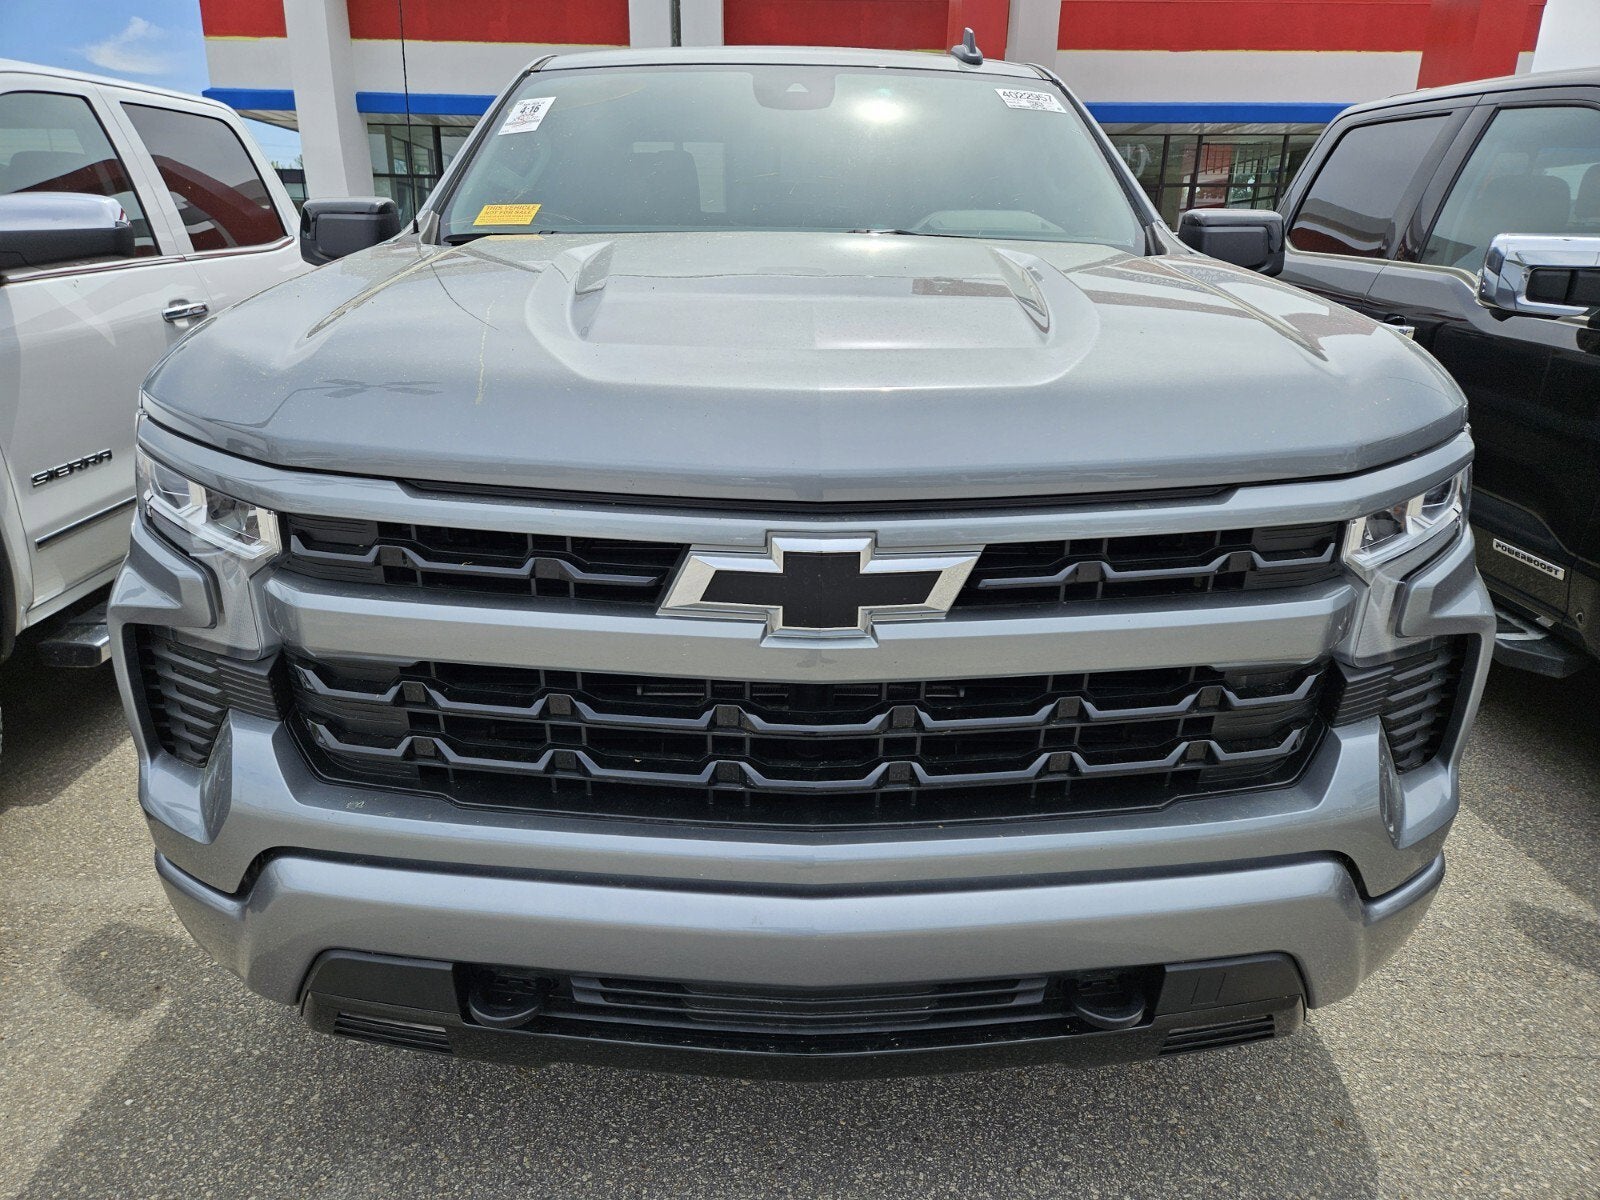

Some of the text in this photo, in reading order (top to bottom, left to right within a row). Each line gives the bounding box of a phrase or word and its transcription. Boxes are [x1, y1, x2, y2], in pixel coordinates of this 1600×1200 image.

[1002, 91, 1052, 102] 4022957
[31, 448, 113, 488] SIERRA
[1495, 541, 1560, 576] POWERBOOST
